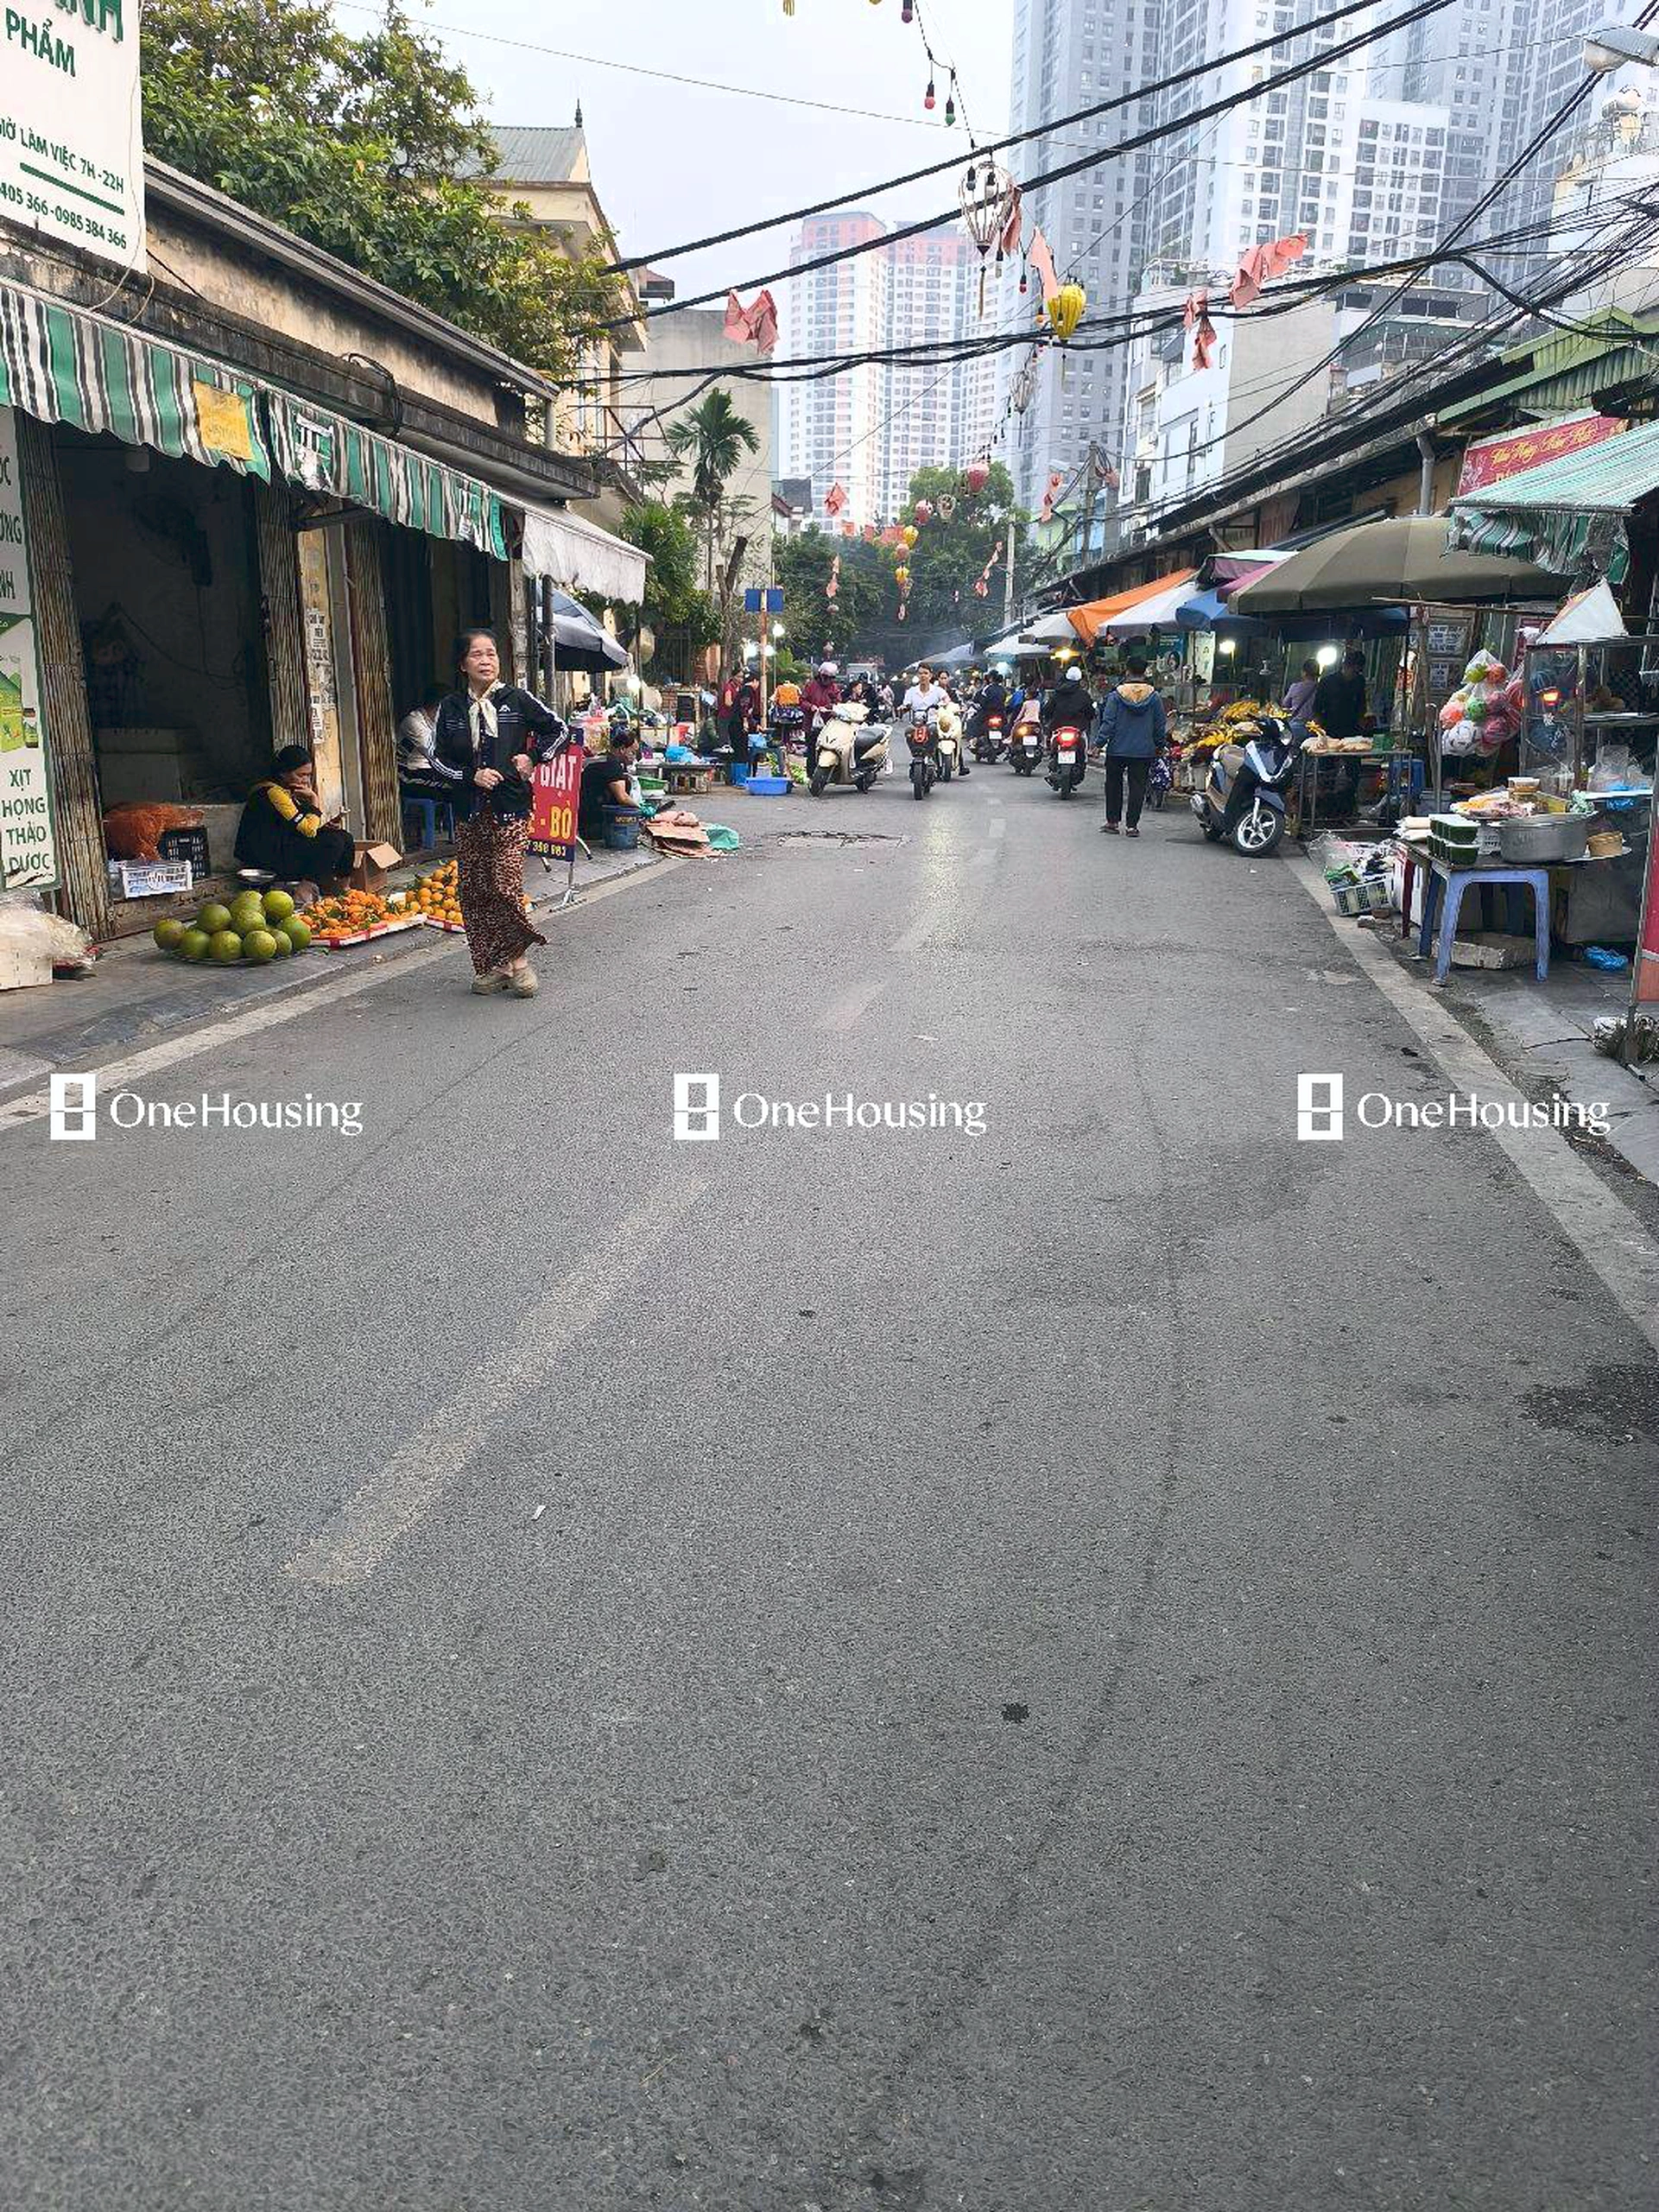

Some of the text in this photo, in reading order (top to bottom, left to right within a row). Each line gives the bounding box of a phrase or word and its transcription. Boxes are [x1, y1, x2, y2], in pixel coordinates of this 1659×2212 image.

[6, 7, 76, 77] PHẨM
[20, 127, 47, 157] LÀM
[50, 143, 76, 171] VIỆC
[108, 228, 126, 249] 366
[9, 769, 32, 791] XỊT
[2, 796, 46, 821] HỌNG
[549, 800, 573, 840] BÒ
